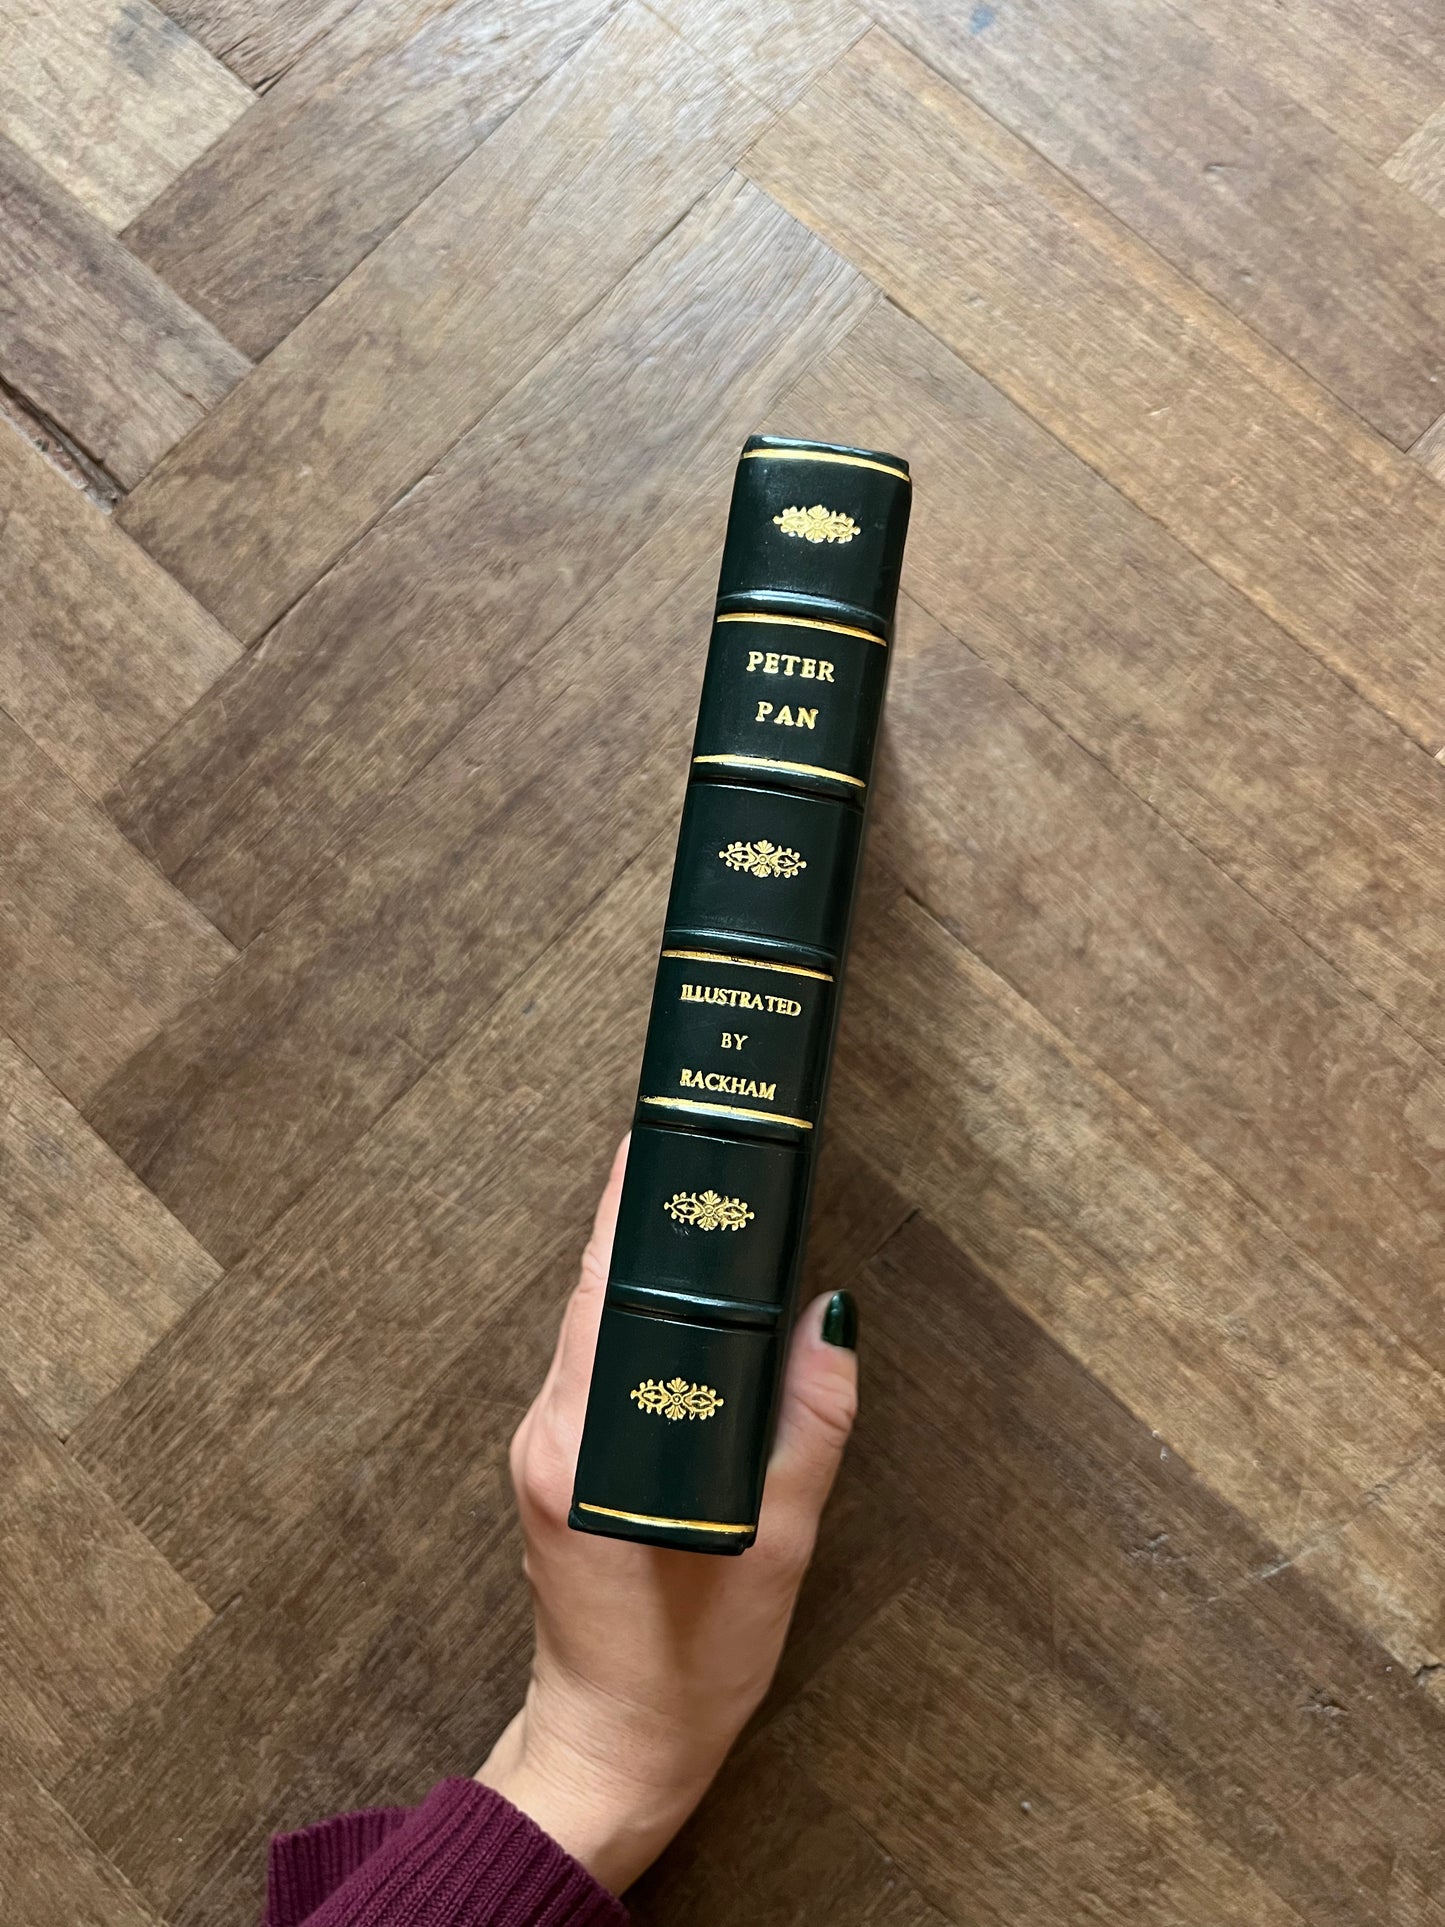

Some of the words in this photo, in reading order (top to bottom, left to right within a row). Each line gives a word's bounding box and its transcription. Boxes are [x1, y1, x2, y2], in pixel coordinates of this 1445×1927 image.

[746, 651, 835, 683] PETER
[755, 701, 819, 730] PAN
[680, 984, 802, 1017] ILLUSTRATED
[721, 1032, 749, 1051] BY
[679, 1068, 777, 1101] RACKHAM
